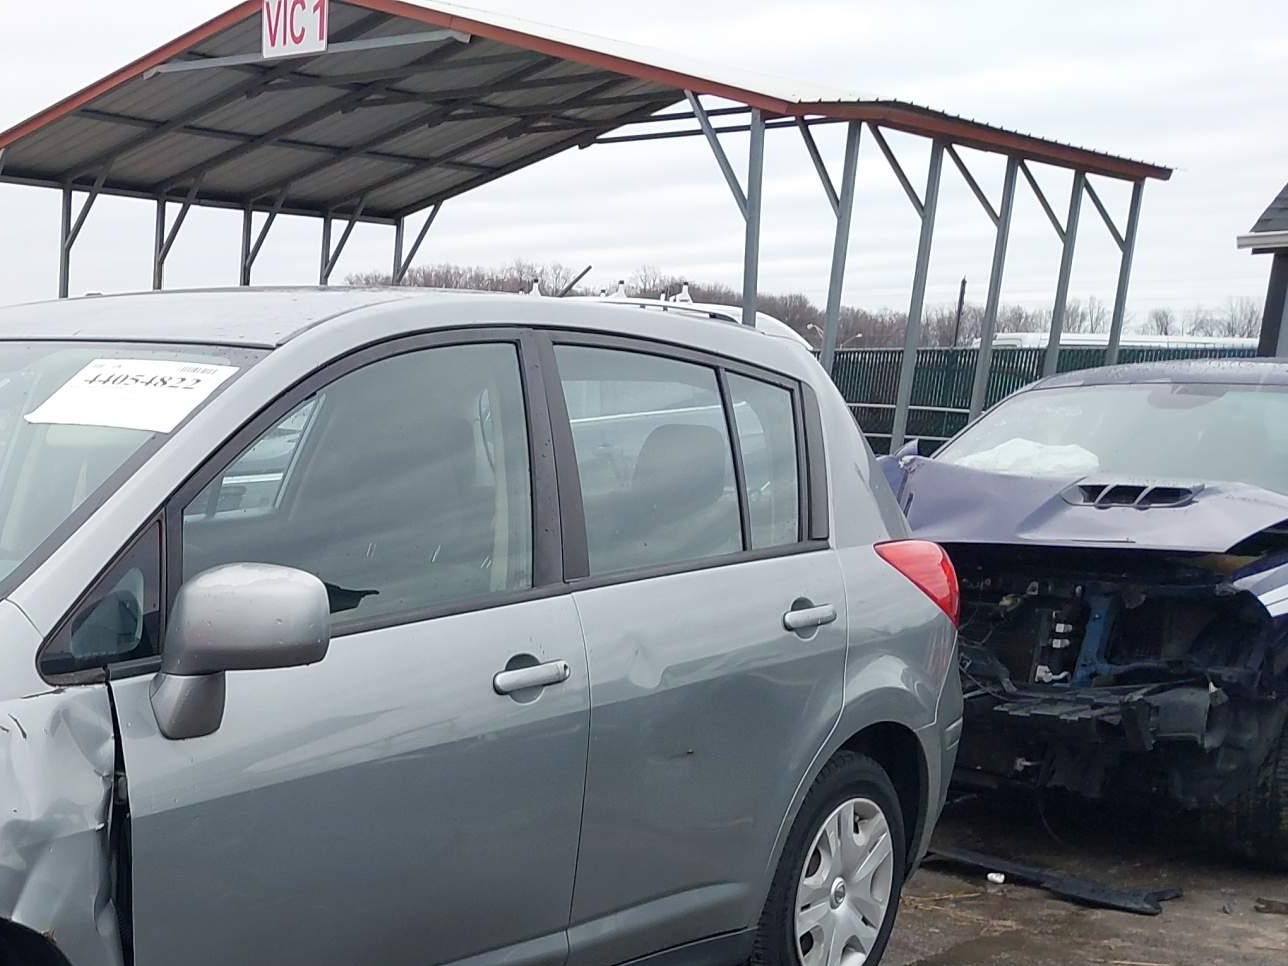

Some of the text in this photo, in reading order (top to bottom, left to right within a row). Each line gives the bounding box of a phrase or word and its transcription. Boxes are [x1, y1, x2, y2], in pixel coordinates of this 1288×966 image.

[265, 0, 326, 47] VIC 1
[83, 372, 203, 390] 44054822
